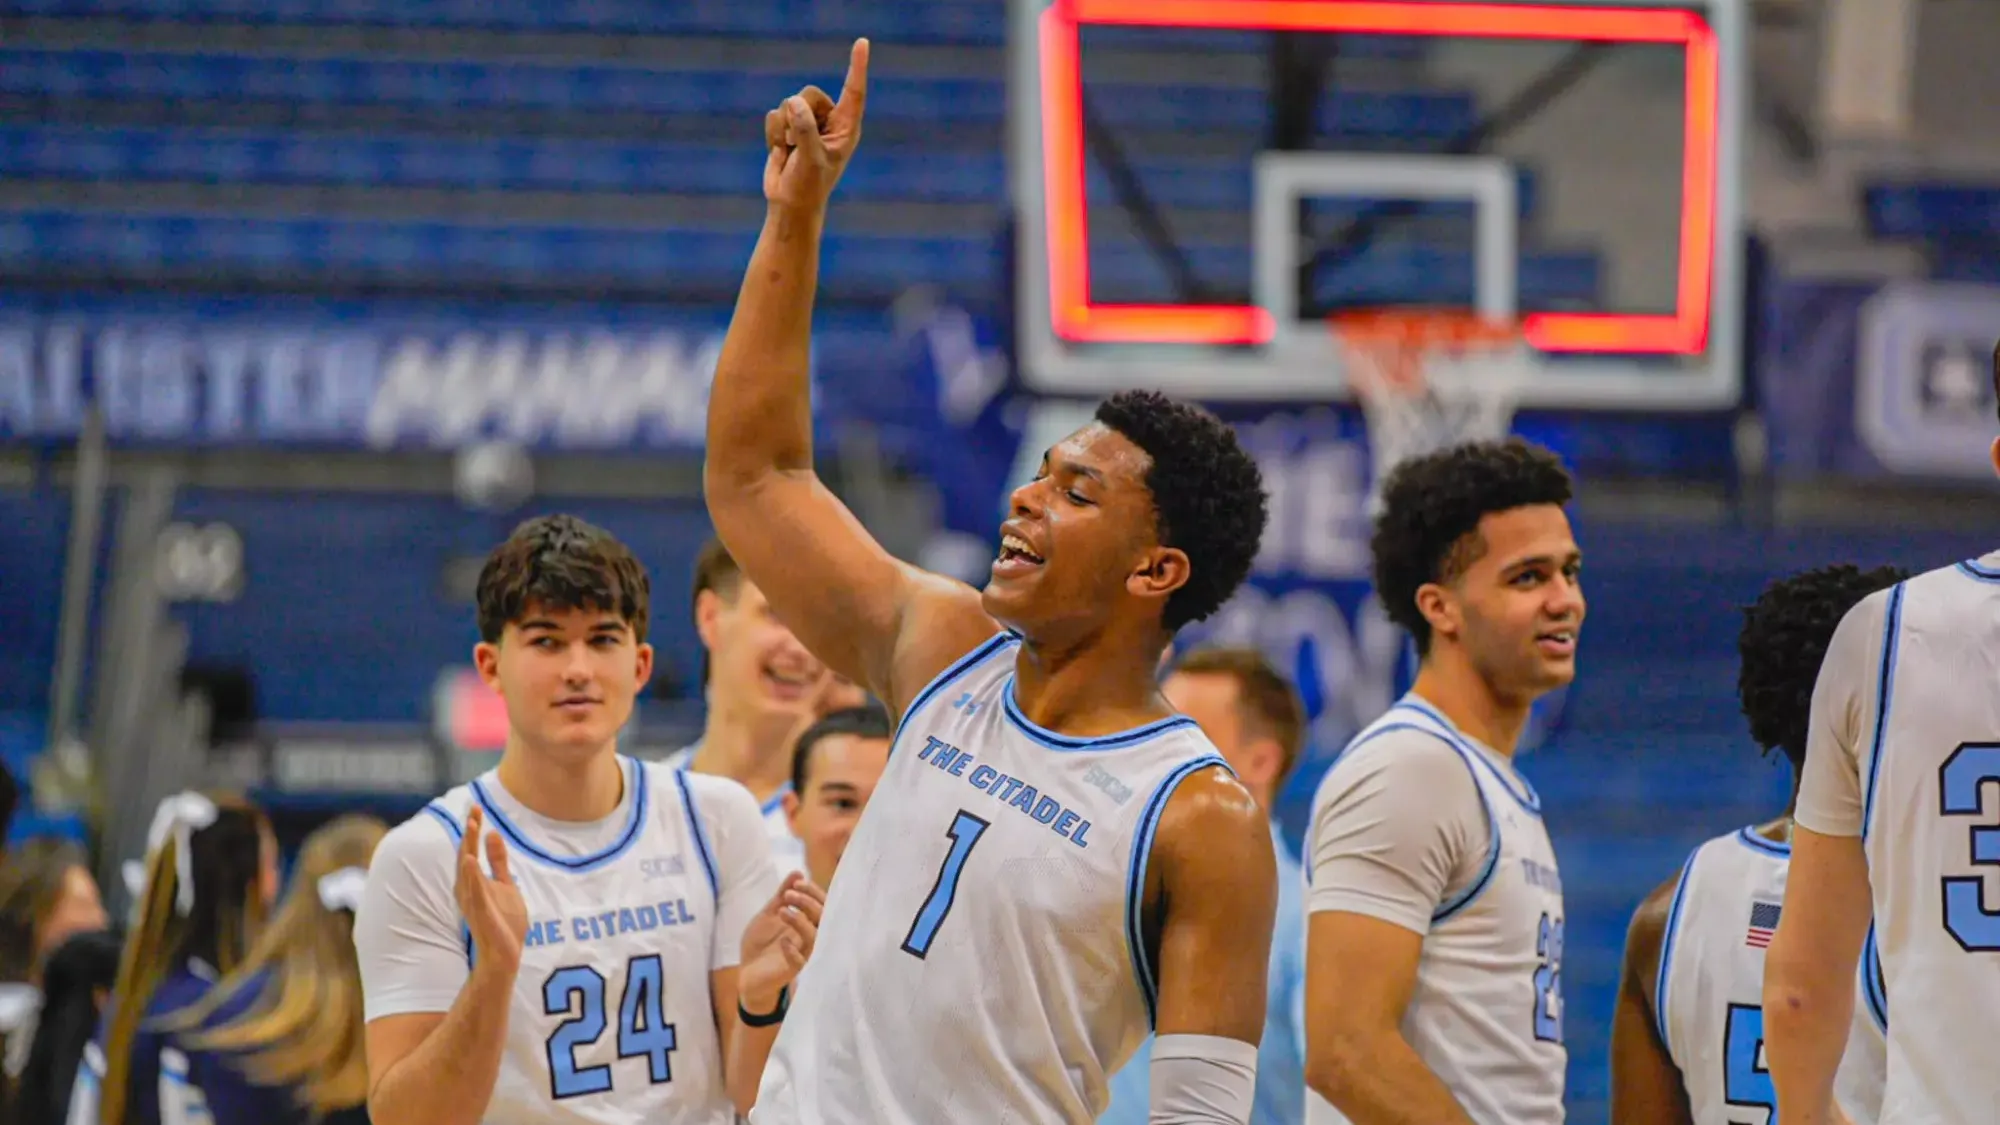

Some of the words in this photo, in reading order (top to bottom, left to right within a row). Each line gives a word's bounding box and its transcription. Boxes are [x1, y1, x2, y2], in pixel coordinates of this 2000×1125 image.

[917, 734, 975, 778] THE
[968, 763, 1093, 849] CITADEL
[524, 919, 566, 947] HE
[571, 898, 696, 942] CITADEL
[899, 808, 992, 961] 1
[541, 953, 678, 1101] 24
